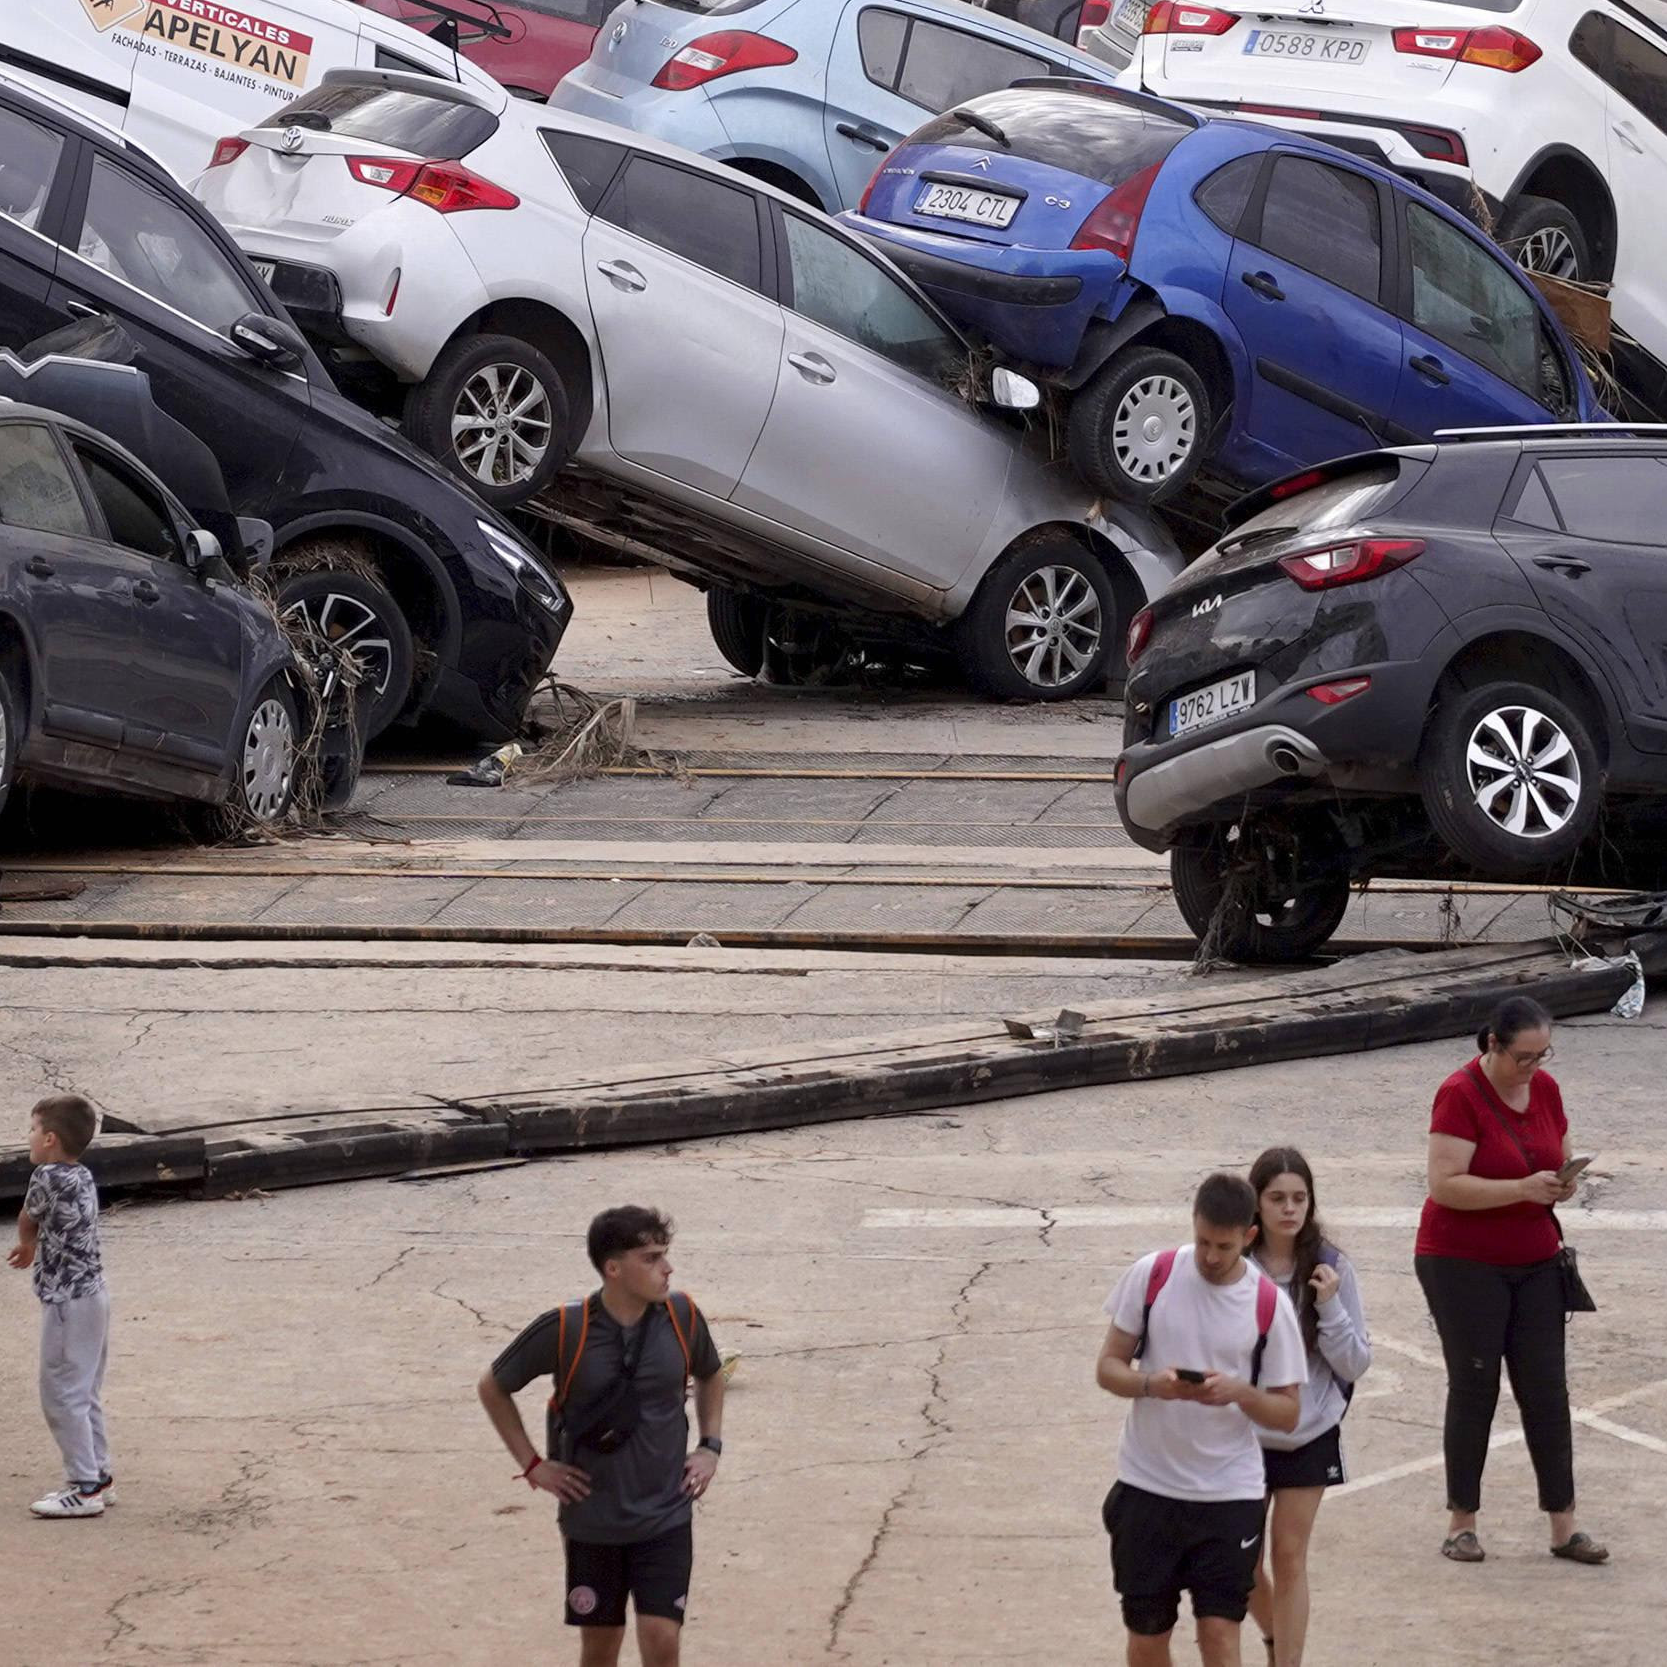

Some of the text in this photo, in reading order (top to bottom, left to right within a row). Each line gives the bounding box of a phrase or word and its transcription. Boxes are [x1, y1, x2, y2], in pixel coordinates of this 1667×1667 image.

[144, 8, 298, 81] APELYAN
[1260, 34, 1365, 61] 0588 KPD
[111, 33, 157, 57] FACHADAS
[164, 50, 207, 74] TERRAZAS
[214, 67, 256, 90] BAJANTES
[928, 188, 1008, 221] 2304 CTL
[1044, 195, 1071, 210] C3
[1191, 594, 1223, 618] KIA
[1179, 677, 1251, 726] 9762 LZW
